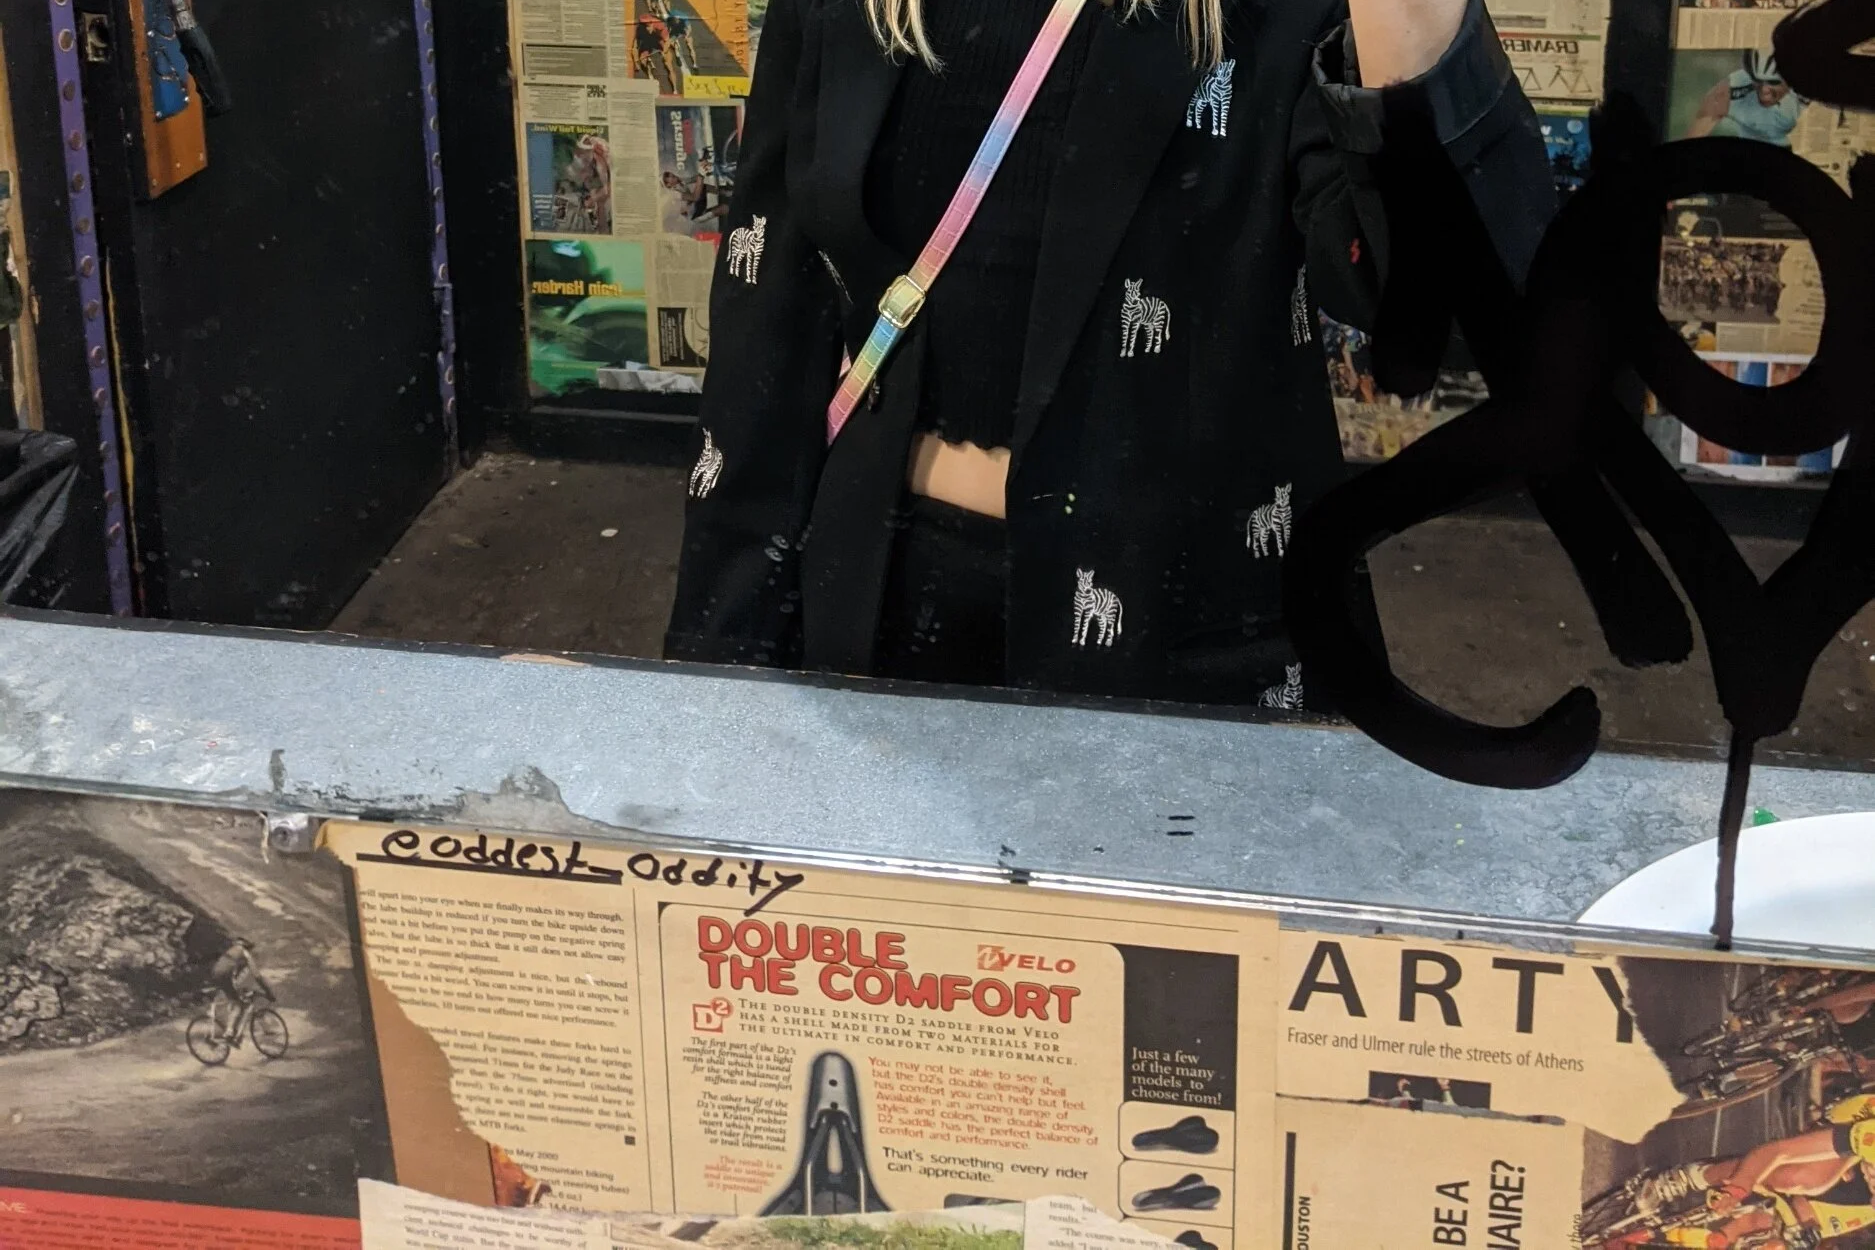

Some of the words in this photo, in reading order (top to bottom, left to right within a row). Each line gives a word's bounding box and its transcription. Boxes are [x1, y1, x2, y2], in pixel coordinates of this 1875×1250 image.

[698, 915, 908, 970] DOUBLE
[998, 951, 1077, 975] VELO
[698, 952, 799, 997] THE
[818, 963, 1081, 1024] COMFORT
[739, 1022, 766, 1034] THE
[772, 1026, 839, 1042] ULTIMATE
[845, 1033, 860, 1043] IN
[866, 1036, 931, 1051] COMFORT
[936, 1042, 965, 1054] AND
[971, 1047, 1079, 1067] PERFORMANCE.
[740, 1011, 768, 1023] HAS
[771, 1015, 778, 1023] A
[784, 1016, 826, 1028] SHELL
[831, 1020, 868, 1033] MADE
[874, 1024, 912, 1038] FROM
[918, 1029, 946, 1041] TWO
[951, 1033, 1028, 1049] MATERIALS
[1034, 1041, 1061, 1053] FOR
[1132, 1046, 1160, 1061] Just
[1163, 1052, 1171, 1062] a
[1175, 1050, 1200, 1064] few
[1288, 1027, 1328, 1046] Fraser
[1332, 1032, 1358, 1049] and
[1362, 1035, 1405, 1054] Ulmer
[1409, 1039, 1436, 1057] rule
[1440, 1042, 1463, 1060] the
[1466, 1047, 1513, 1066] streets
[1516, 1051, 1532, 1067] of
[1534, 1053, 1585, 1072] Athens
[1132, 1060, 1148, 1072] of
[1150, 1061, 1172, 1075] the
[1176, 1067, 1216, 1082] many
[1132, 1074, 1182, 1088] models
[1190, 1079, 1204, 1090] to
[1132, 1086, 1180, 1101] choose
[1183, 1090, 1222, 1106] from!
[882, 1146, 924, 1162] That's
[930, 1153, 1004, 1172] something
[1011, 1162, 1049, 1178] every
[1055, 1167, 1089, 1181] rider
[887, 1162, 912, 1173] can
[918, 1165, 995, 1183] appreciate.
[1435, 1180, 1470, 1204] A
[1433, 1207, 1468, 1247] BE
